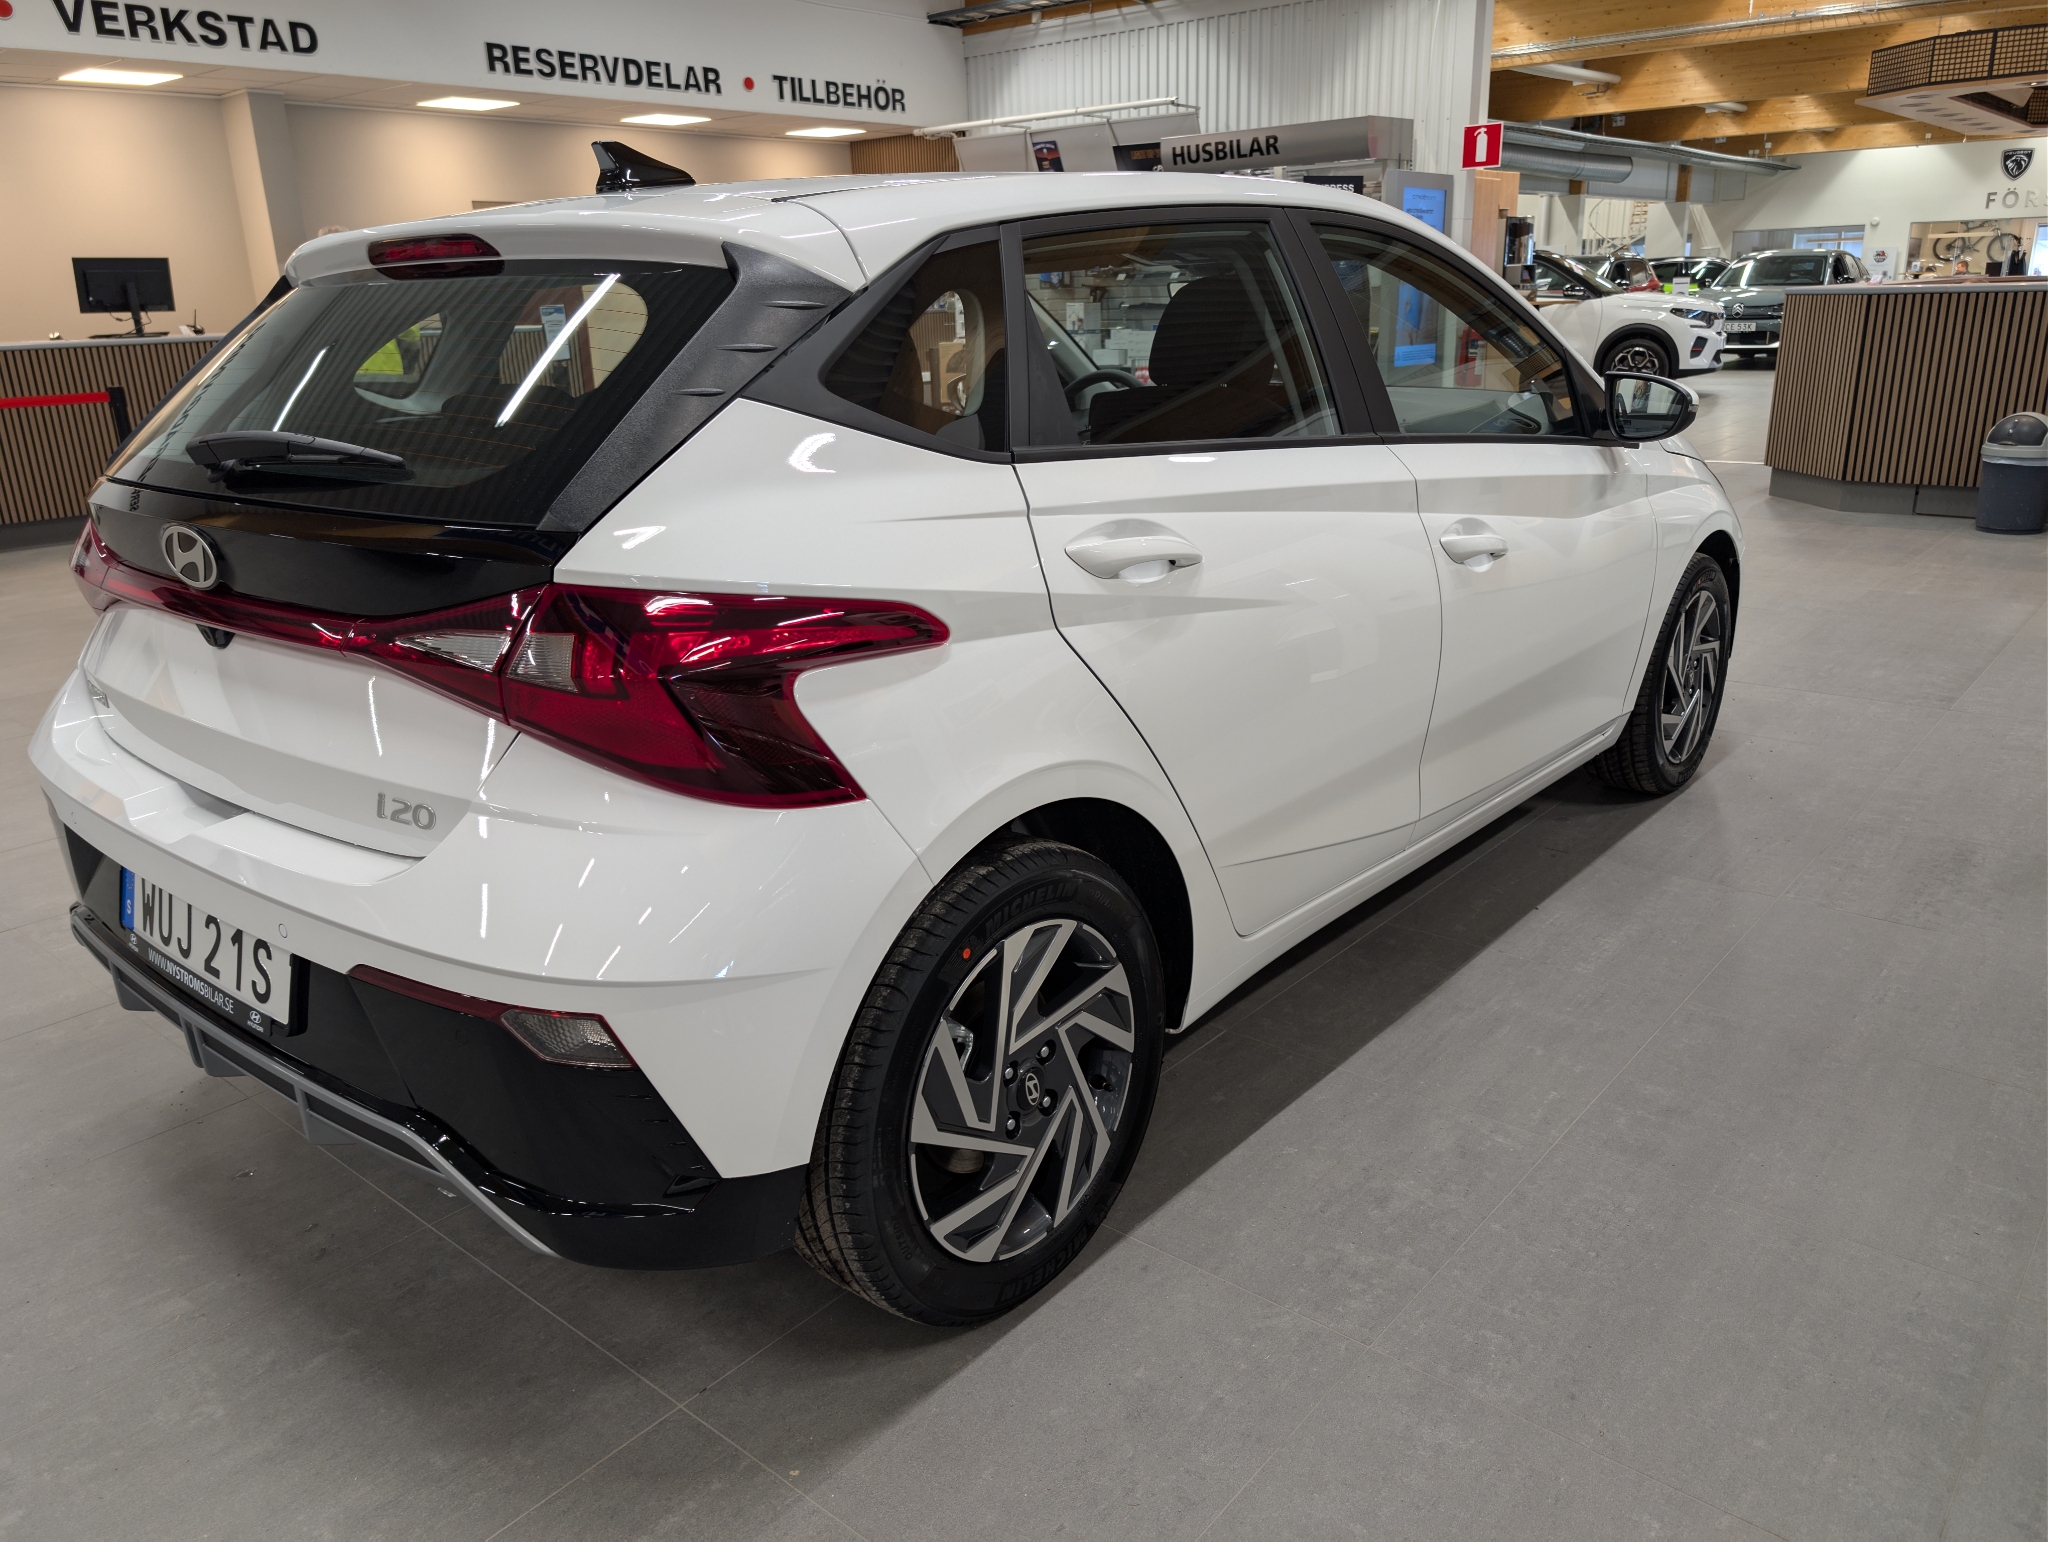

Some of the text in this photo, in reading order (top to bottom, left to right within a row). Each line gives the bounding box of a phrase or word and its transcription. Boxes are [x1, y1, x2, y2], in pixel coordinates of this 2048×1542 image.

[53, 0, 319, 54] VERKSTAD
[485, 42, 906, 112] RESERVDELAR TILLBEHÖR
[1172, 135, 1280, 166] HUSBILAR
[1723, 323, 1735, 331] CE
[377, 792, 437, 830] i20
[985, 882, 1077, 939] MICHELIN
[141, 877, 272, 1004] WUJ 21S
[148, 948, 234, 1014] WWW.NYSTROMSBILAR.SE
